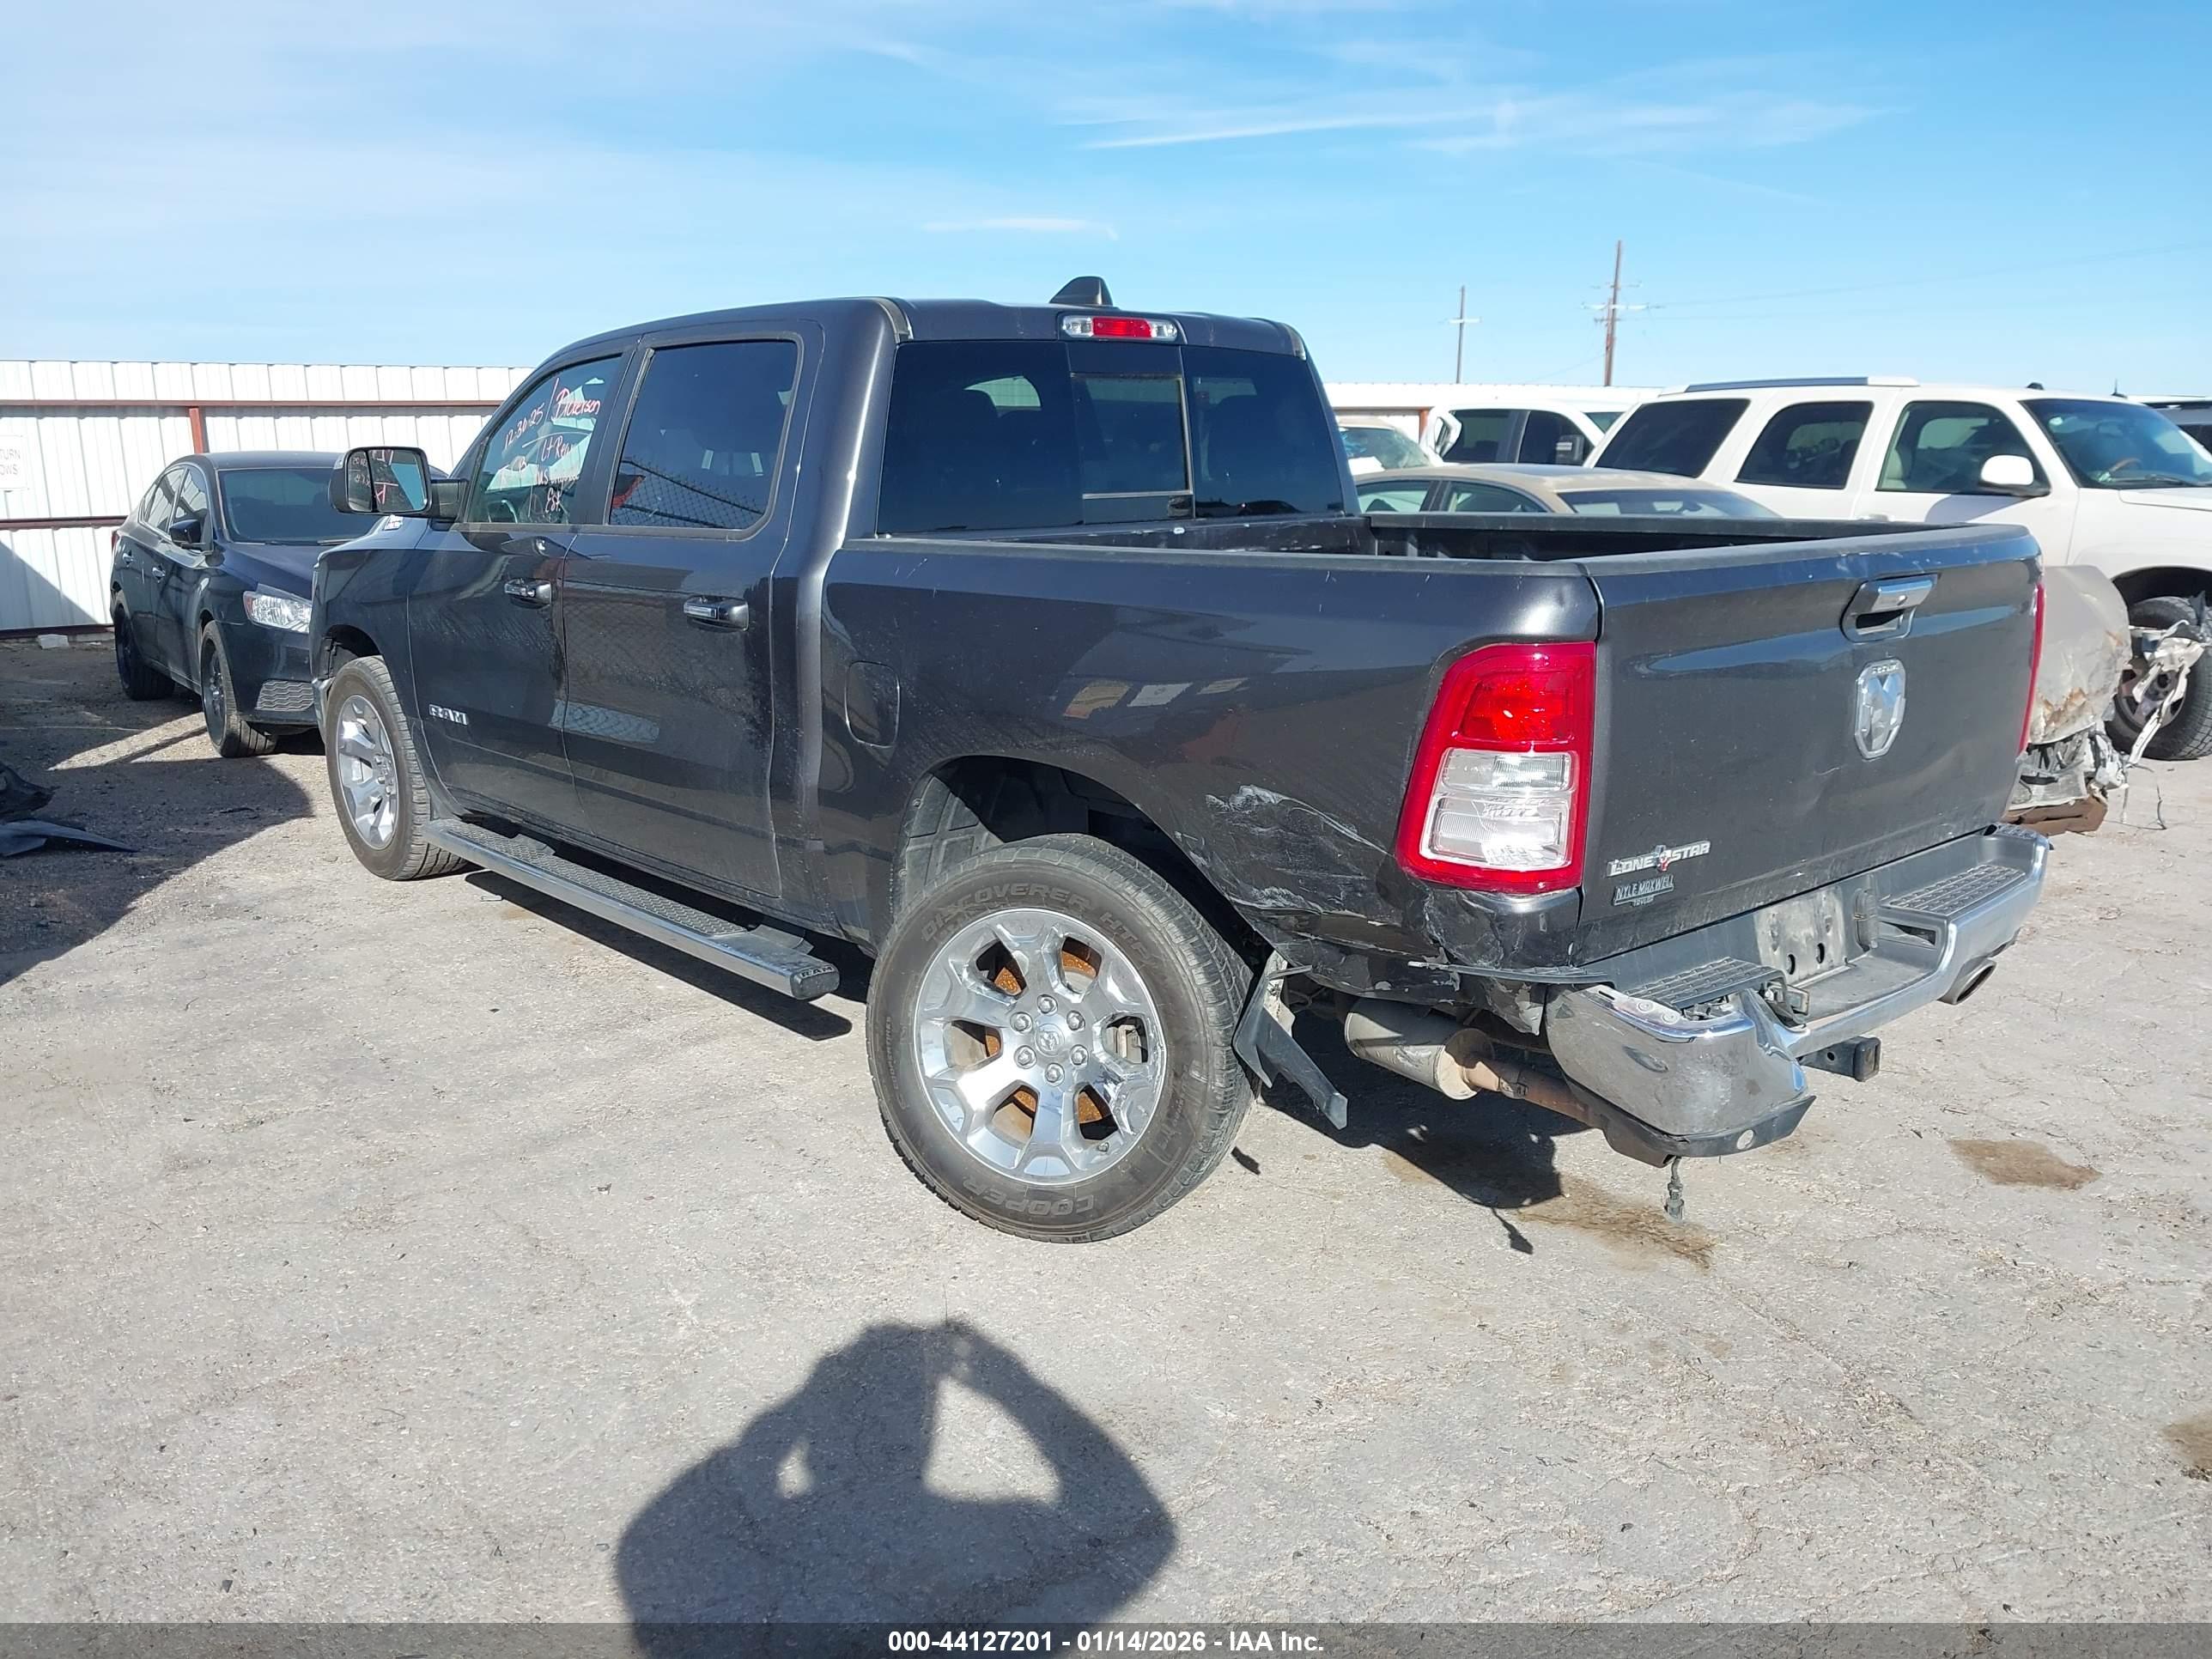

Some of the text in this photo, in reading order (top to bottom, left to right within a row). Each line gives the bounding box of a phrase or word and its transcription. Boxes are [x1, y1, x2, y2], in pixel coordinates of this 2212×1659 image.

[429, 704, 468, 726] RAM
[1607, 841, 1711, 877] LONE STAR
[1638, 874, 1674, 896] MAXWELL
[921, 882, 1094, 942] DISCOVERER
[962, 1176, 1095, 1216] COOPER
